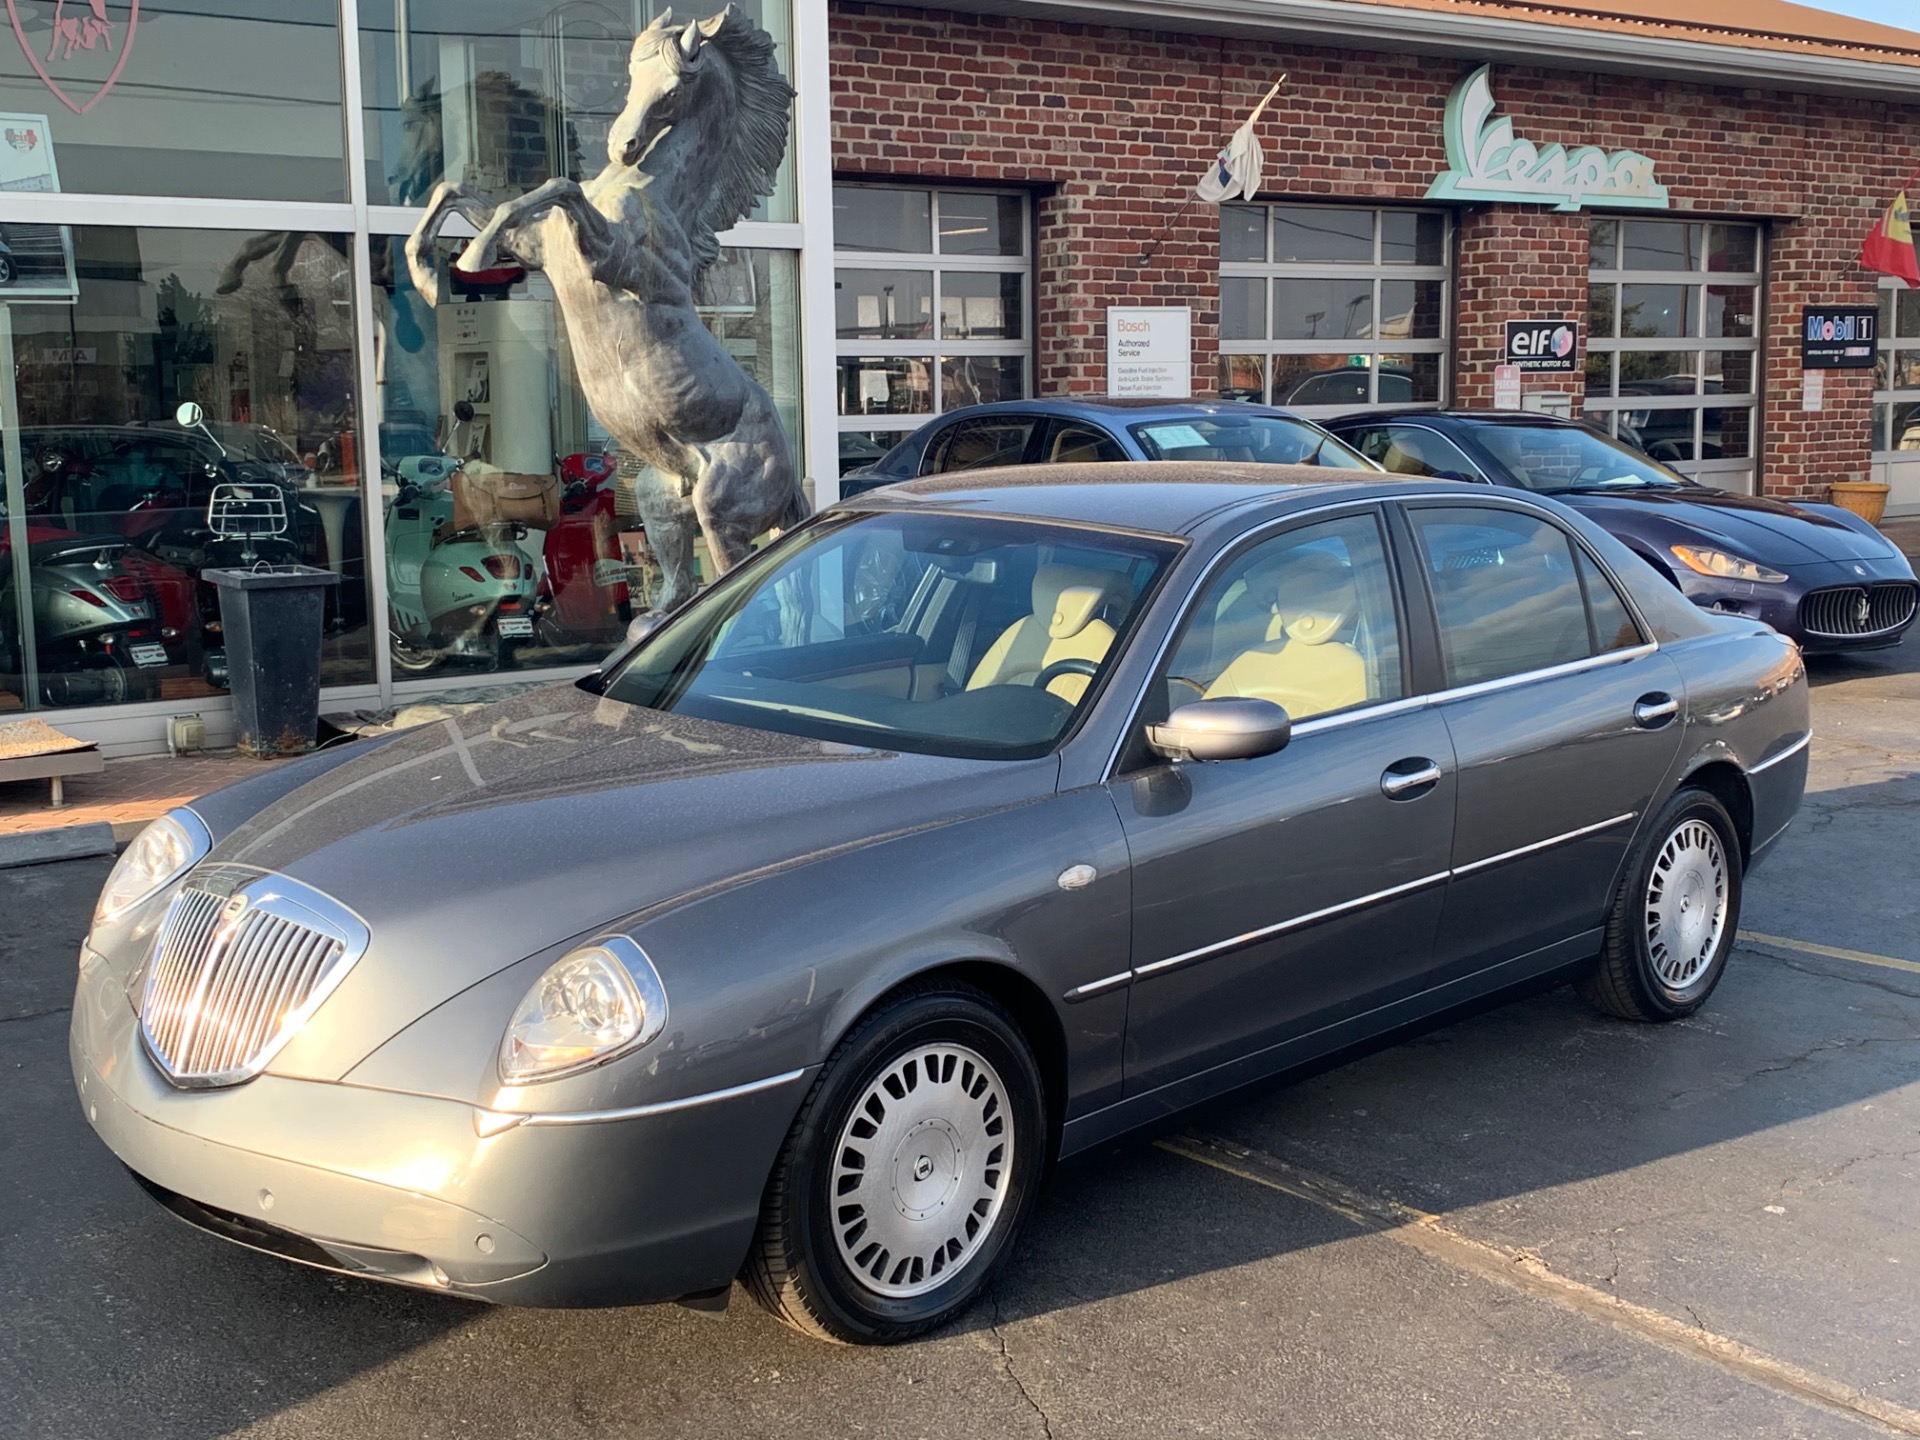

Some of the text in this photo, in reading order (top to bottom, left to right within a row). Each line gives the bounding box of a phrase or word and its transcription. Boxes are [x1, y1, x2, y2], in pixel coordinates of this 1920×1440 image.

[1438, 66, 1667, 208] Vespa
[1117, 319, 1150, 332] Bosch
[1807, 315, 1855, 341] Mobil
[1118, 339, 1150, 348] Authorized
[1511, 329, 1551, 355] elf
[1118, 349, 1141, 357] Service
[1512, 360, 1541, 368] SYNTHETIC
